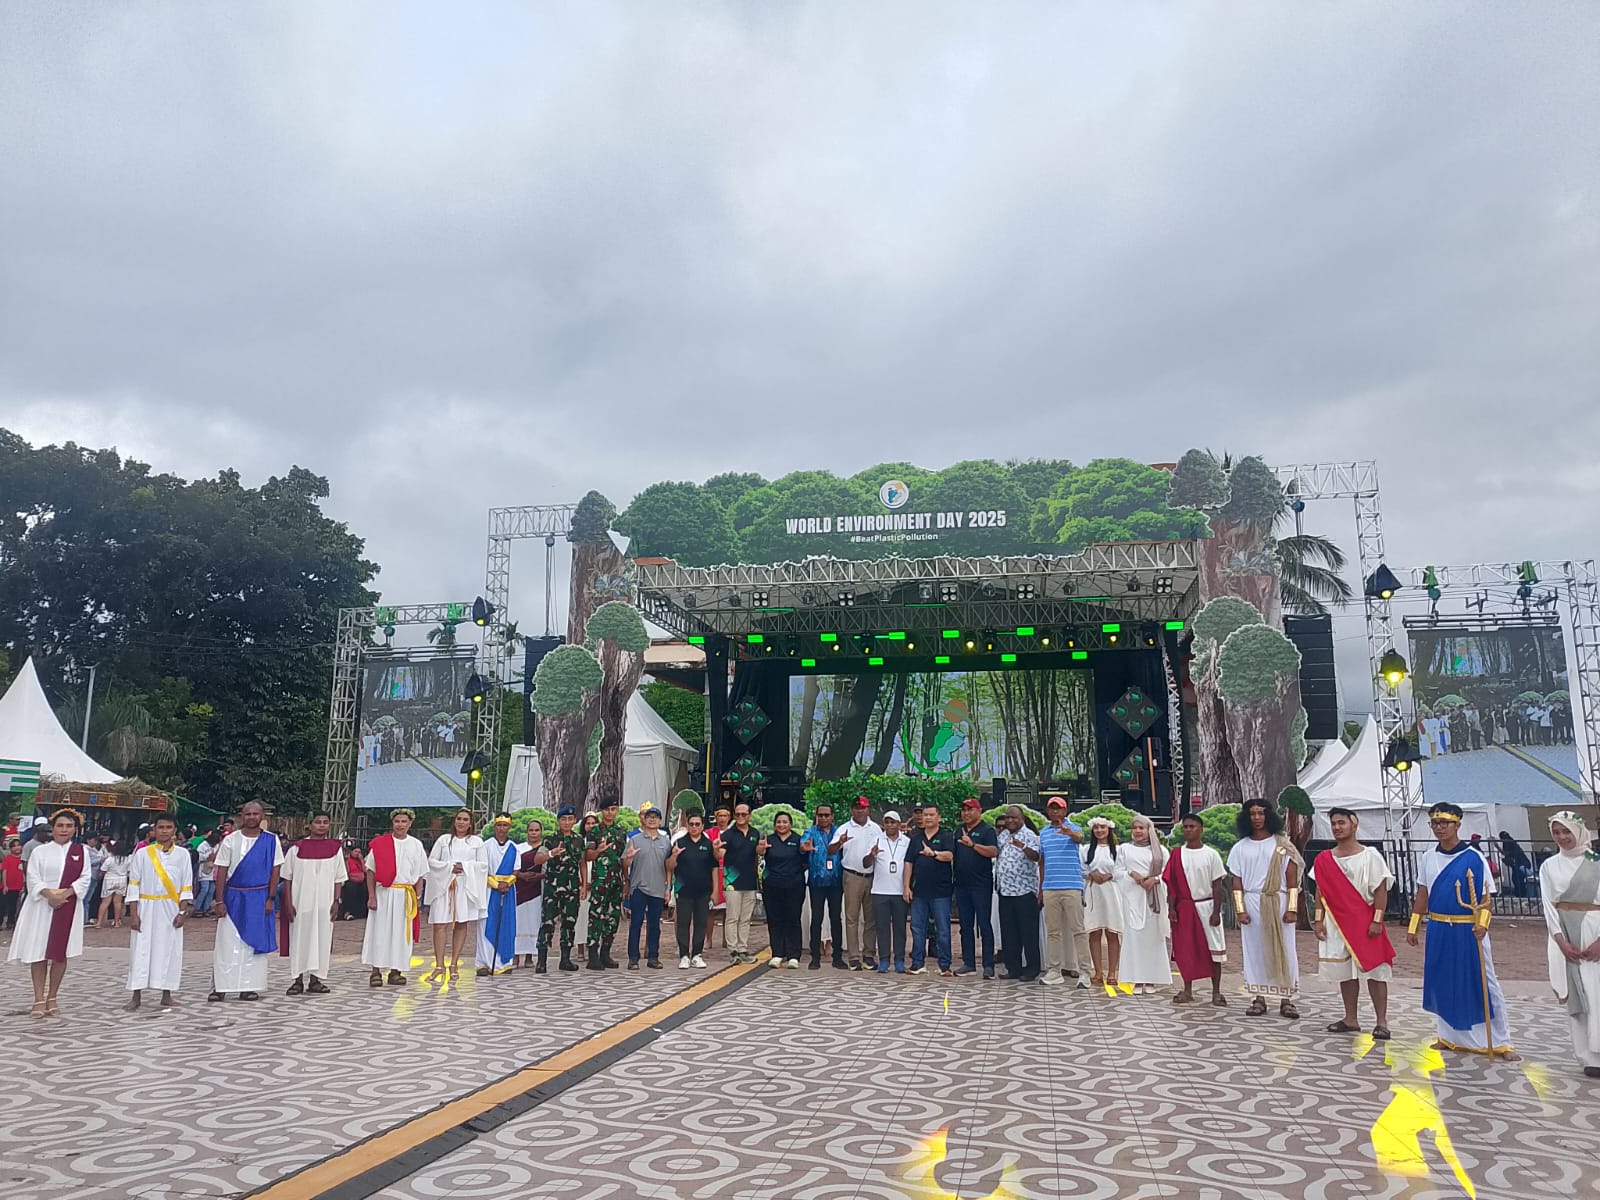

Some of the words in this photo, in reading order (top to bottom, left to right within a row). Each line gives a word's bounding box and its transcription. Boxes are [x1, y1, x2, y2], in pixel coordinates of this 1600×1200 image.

[786, 517, 832, 534] WORLD
[837, 513, 931, 532] ENVIRONMENT
[937, 511, 963, 528] DAY
[969, 510, 1006, 527] 2025
[850, 533, 938, 543] #BeatPlasticPollution
